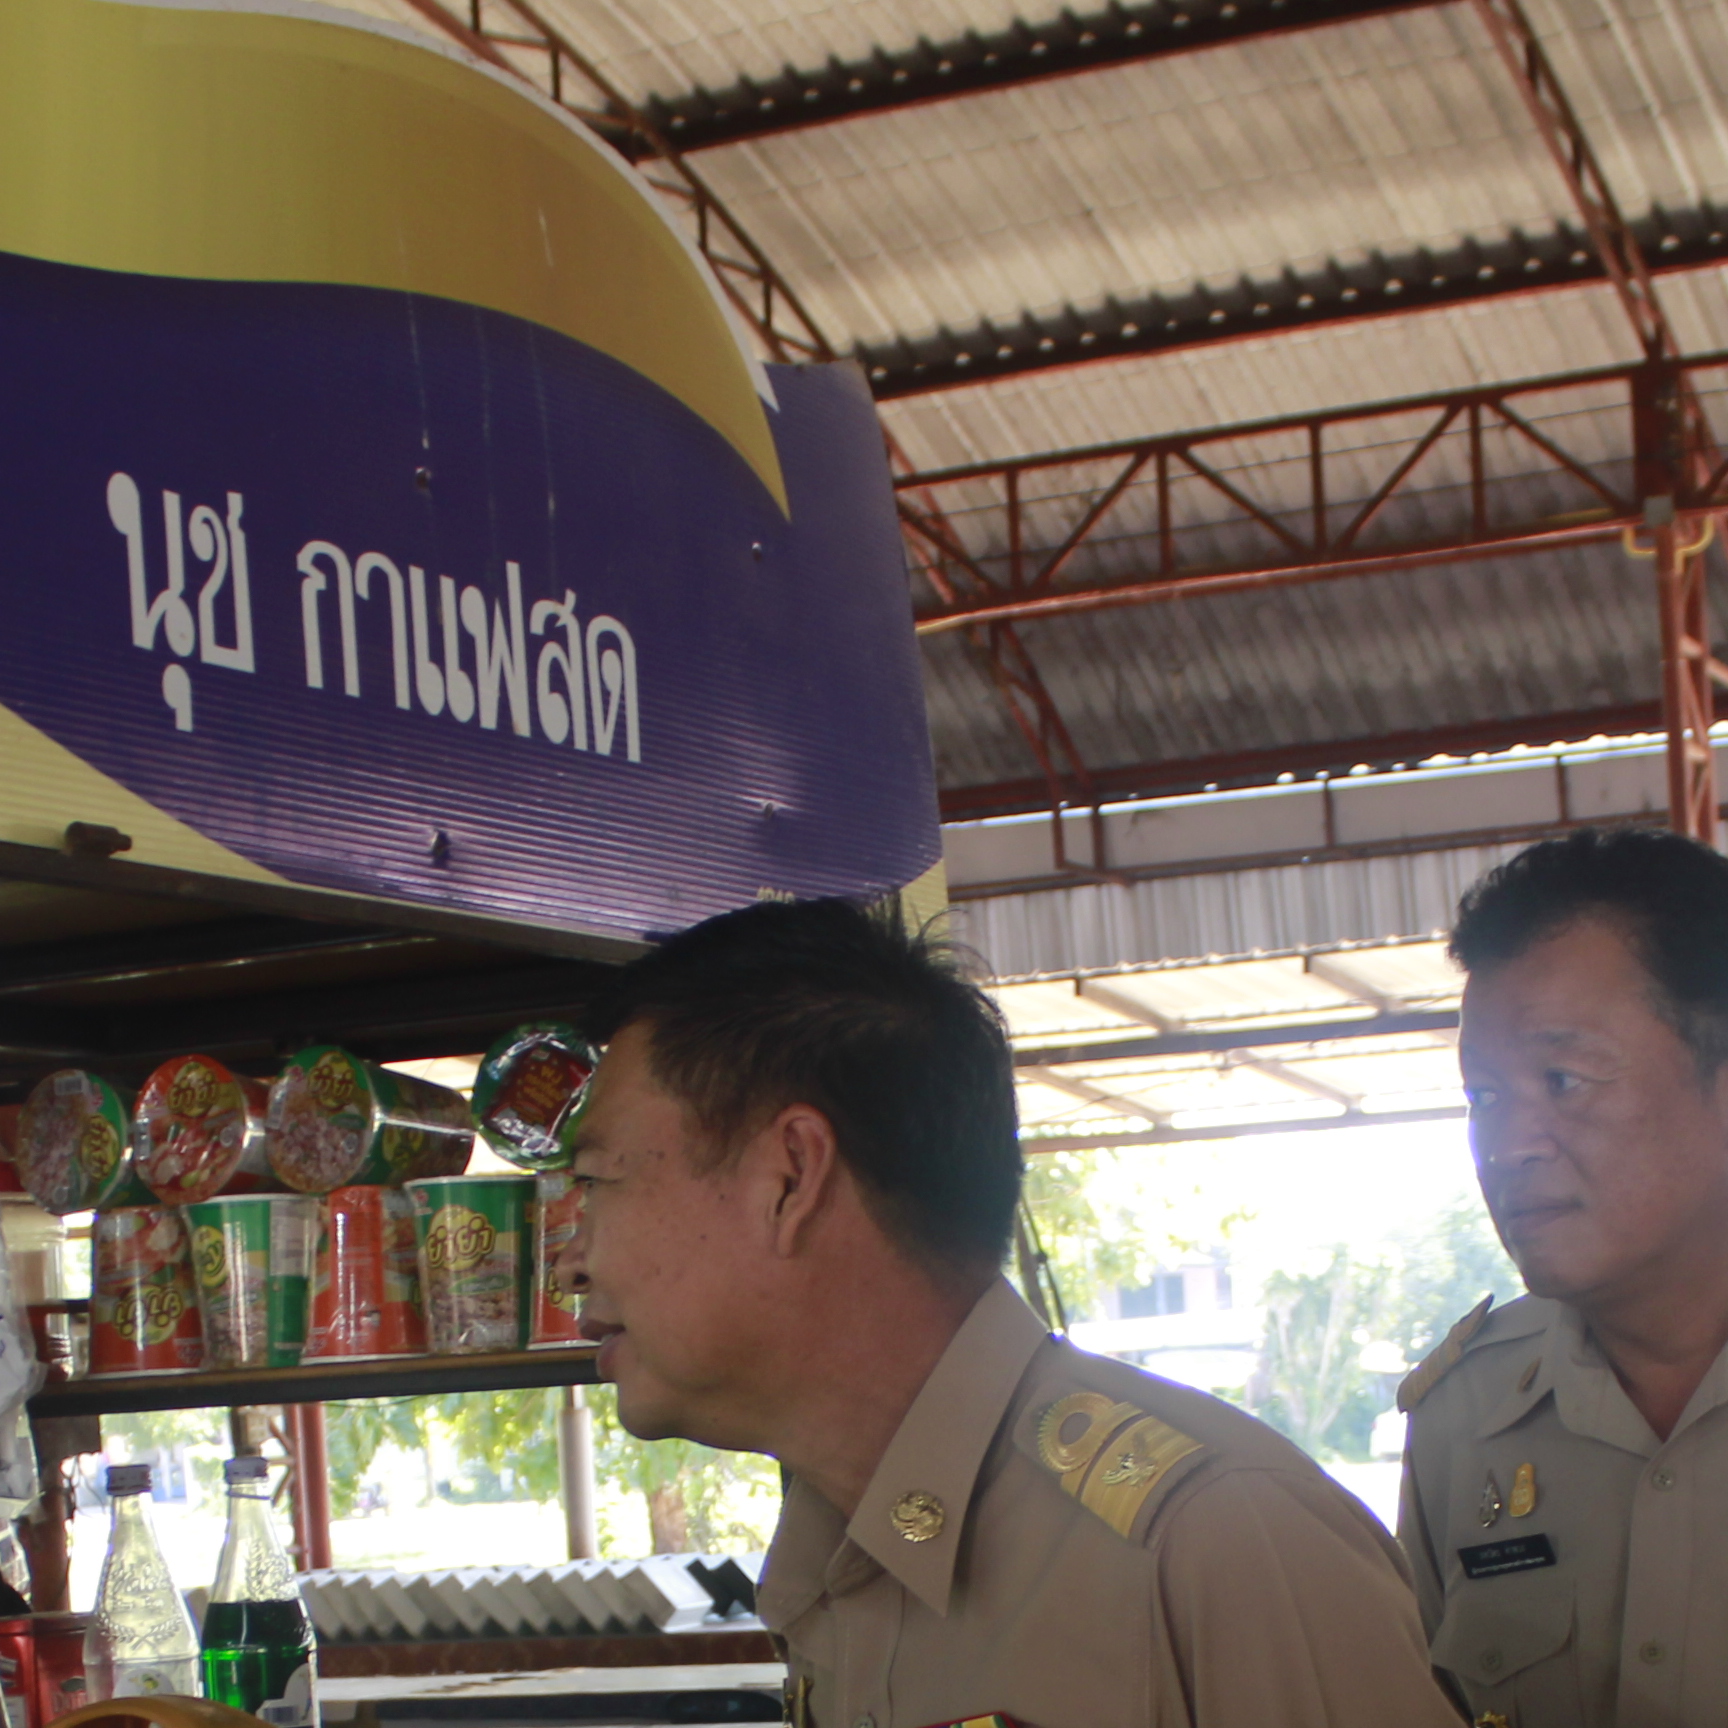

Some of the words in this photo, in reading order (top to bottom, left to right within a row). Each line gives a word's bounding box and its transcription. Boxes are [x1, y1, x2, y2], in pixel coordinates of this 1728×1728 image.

[107, 472, 255, 732] นุช
[296, 540, 641, 763] กาแฟสด
